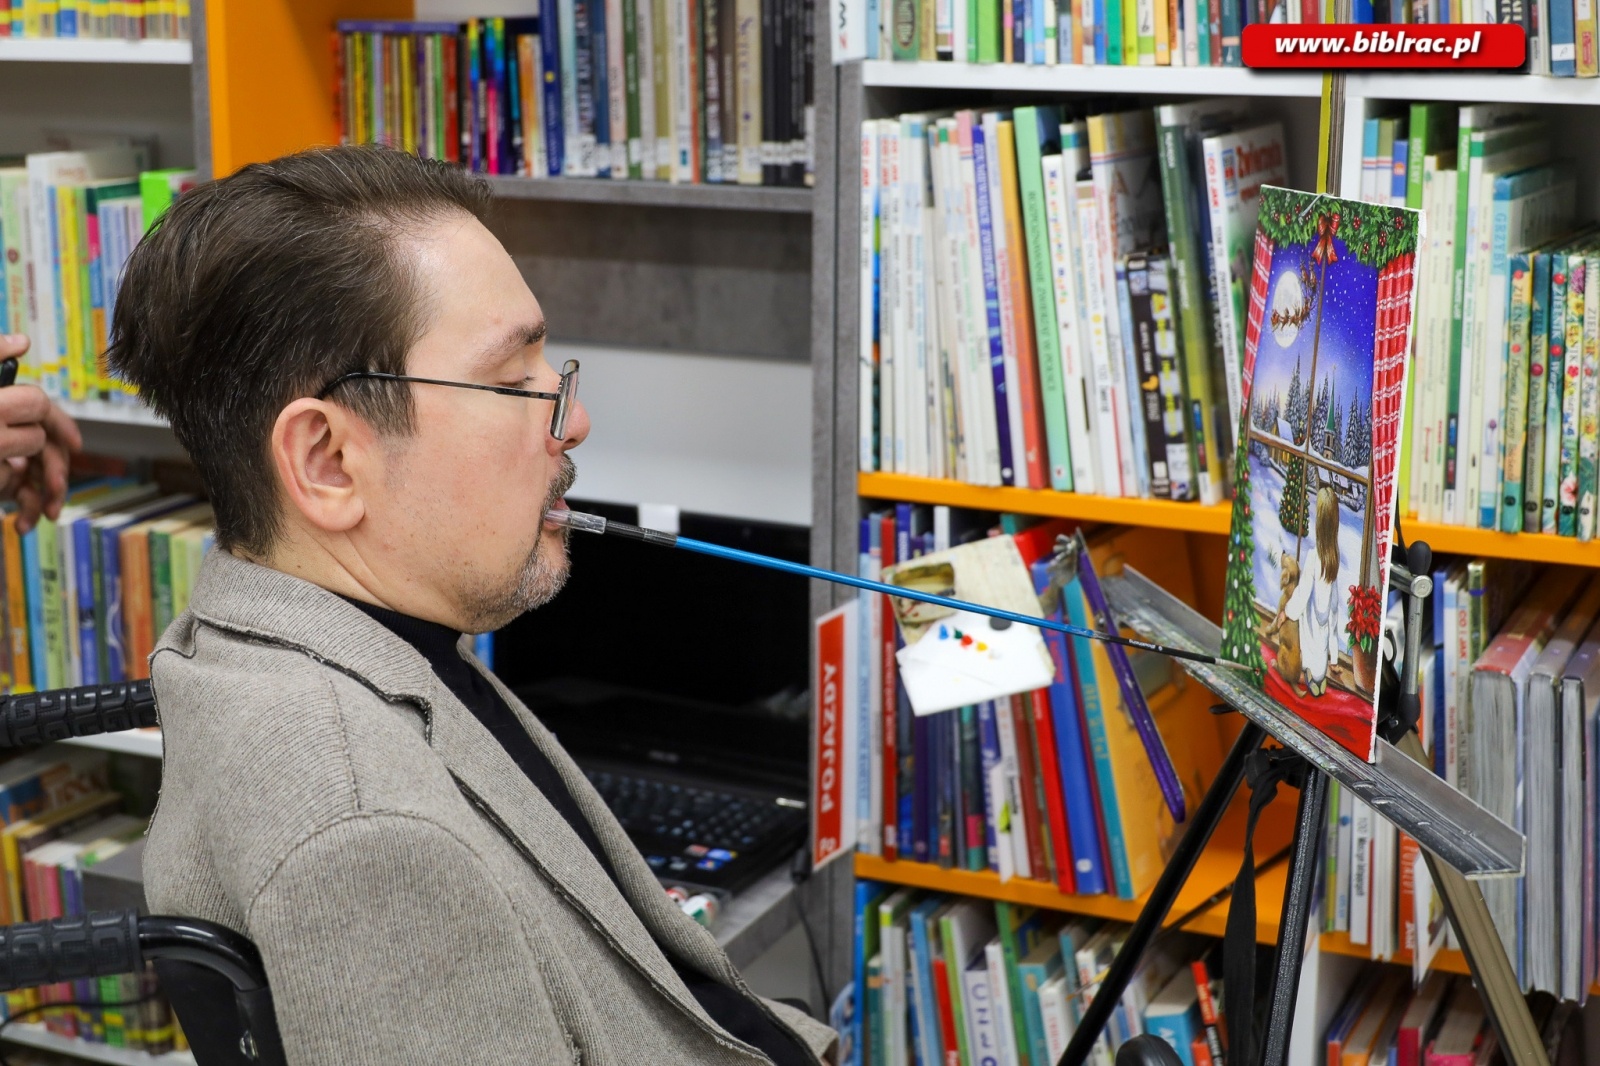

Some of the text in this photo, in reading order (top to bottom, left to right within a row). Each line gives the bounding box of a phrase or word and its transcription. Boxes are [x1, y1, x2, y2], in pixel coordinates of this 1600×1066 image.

[1207, 157, 1216, 177] CO
[1410, 137, 1423, 184] ROŚLINY
[1211, 186, 1220, 208] JAK
[1493, 212, 1507, 271] GRZYBY
[1028, 191, 1046, 284] ROZPOZNAWANIE
[1043, 353, 1056, 392] POLSCE
[1510, 284, 1523, 336] ZIELNIK
[1550, 285, 1564, 339] ZIELNIK
[1531, 308, 1544, 356] ZIELNIK
[1568, 311, 1580, 365] ZIELNIK
[1585, 306, 1598, 358] ZIELNIK
[1508, 358, 1520, 398] Drzewa
[1507, 406, 1518, 441] krzewy
[1459, 609, 1467, 628] CO
[1459, 639, 1467, 660] JAK
[821, 661, 837, 814] POJAZDY
[1357, 816, 1367, 834] 100
